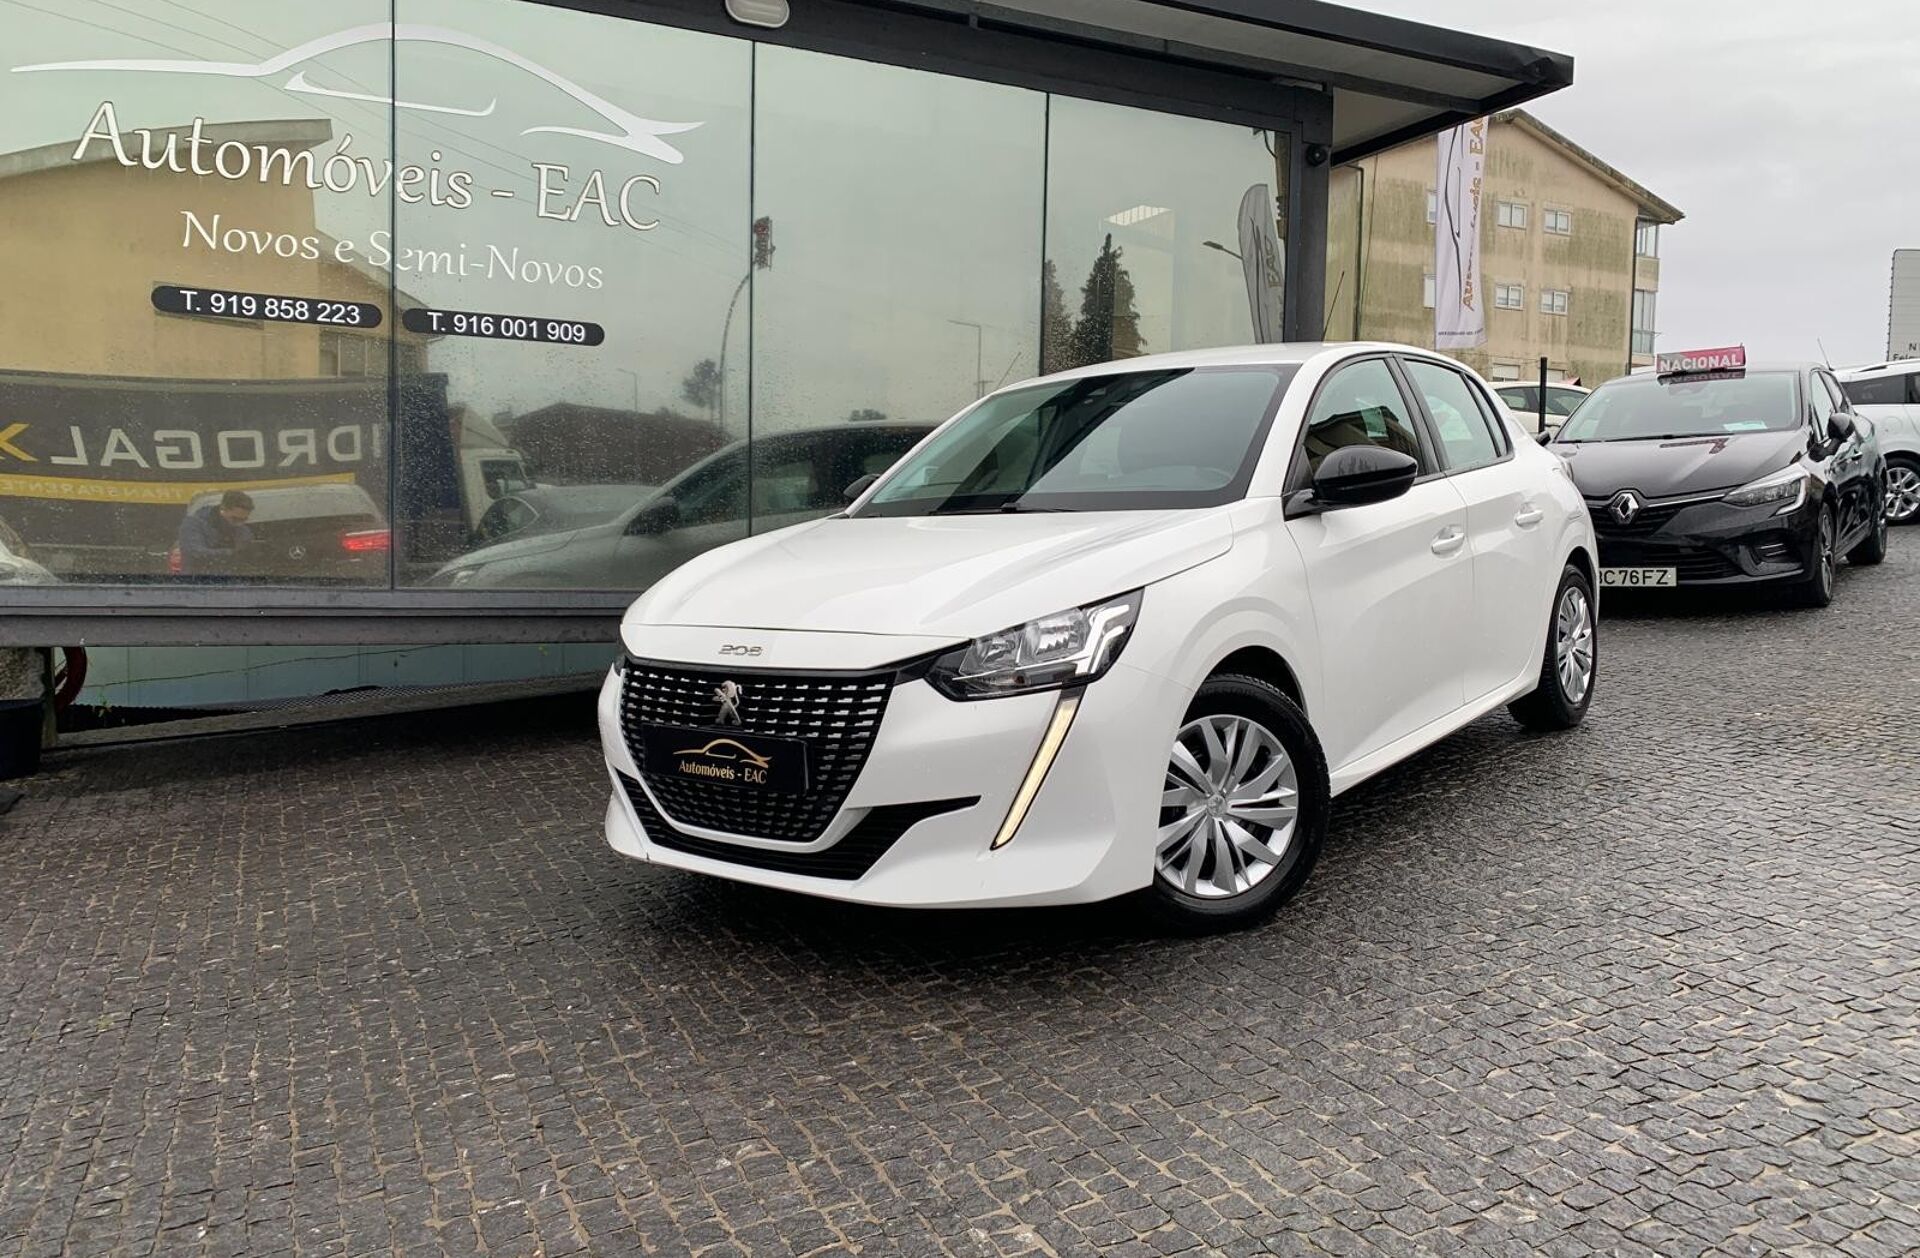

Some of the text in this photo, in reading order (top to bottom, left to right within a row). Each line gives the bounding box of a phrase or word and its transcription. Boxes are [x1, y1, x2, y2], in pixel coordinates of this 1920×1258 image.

[72, 101, 473, 209] Automóveis
[531, 162, 662, 232] EAC
[181, 211, 604, 291] Novos e Semi-Novos
[180, 290, 361, 325] T. 919 858 223
[427, 311, 586, 344] T. 916 001 909
[1659, 354, 1741, 372] NACIONAL
[718, 644, 763, 657] 208
[679, 760, 735, 780] Automóveis
[744, 767, 768, 784] EAC
